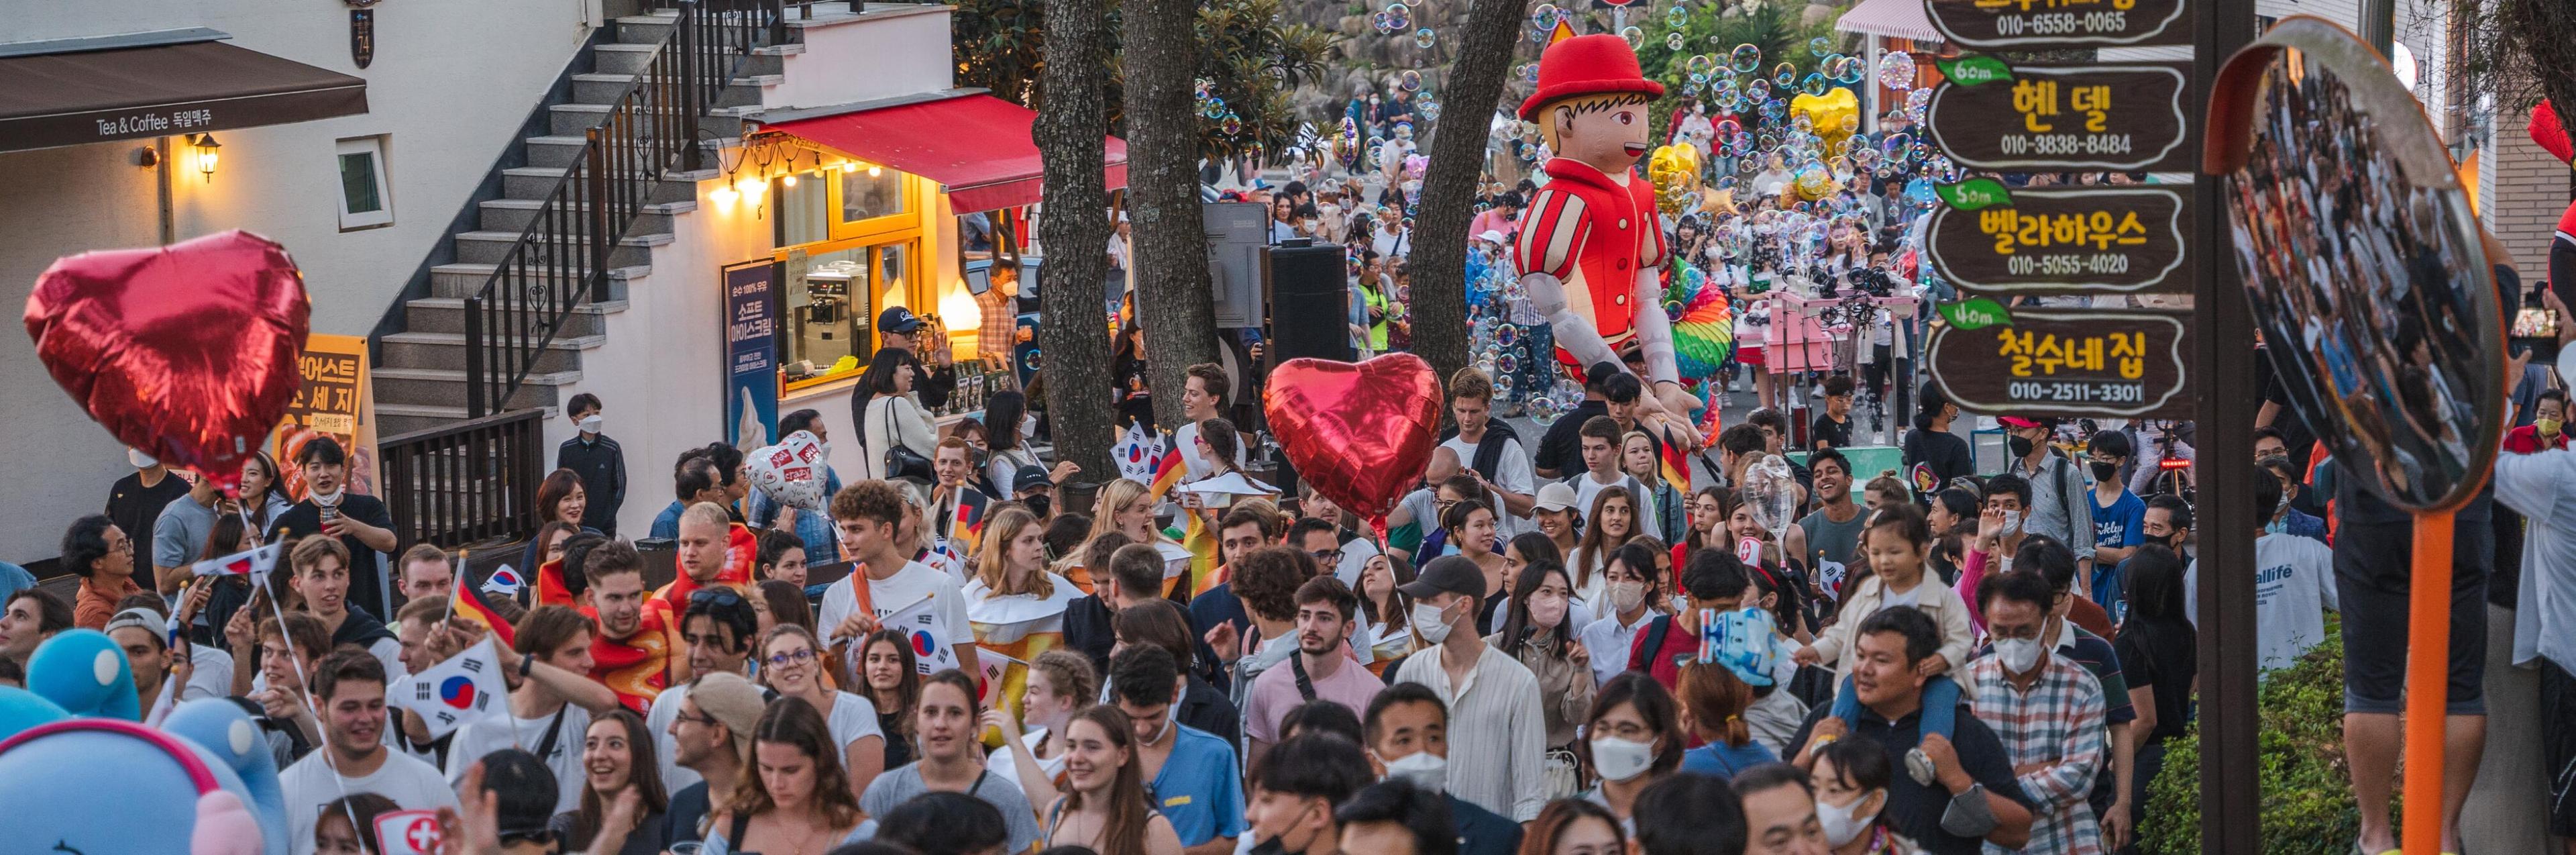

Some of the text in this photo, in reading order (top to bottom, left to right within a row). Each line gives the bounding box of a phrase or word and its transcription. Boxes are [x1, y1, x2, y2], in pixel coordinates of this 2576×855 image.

[1996, 11, 2126, 35] 010-6558-0065
[357, 35, 370, 54] 74
[97, 109, 211, 136] Tea & Coffee 독일맥주
[2000, 134, 2132, 155] 010-3838-8484
[1980, 209, 2147, 254] 벨라하우스
[2008, 254, 2128, 274] 010-5055-4020
[743, 283, 757, 295] 100%
[739, 300, 763, 321] 소프트
[731, 317, 771, 342] 아이스크림
[1997, 328, 2146, 379] 철수네 집
[2008, 382, 2143, 401] 010-2511-3301
[785, 468, 810, 480] crazy
